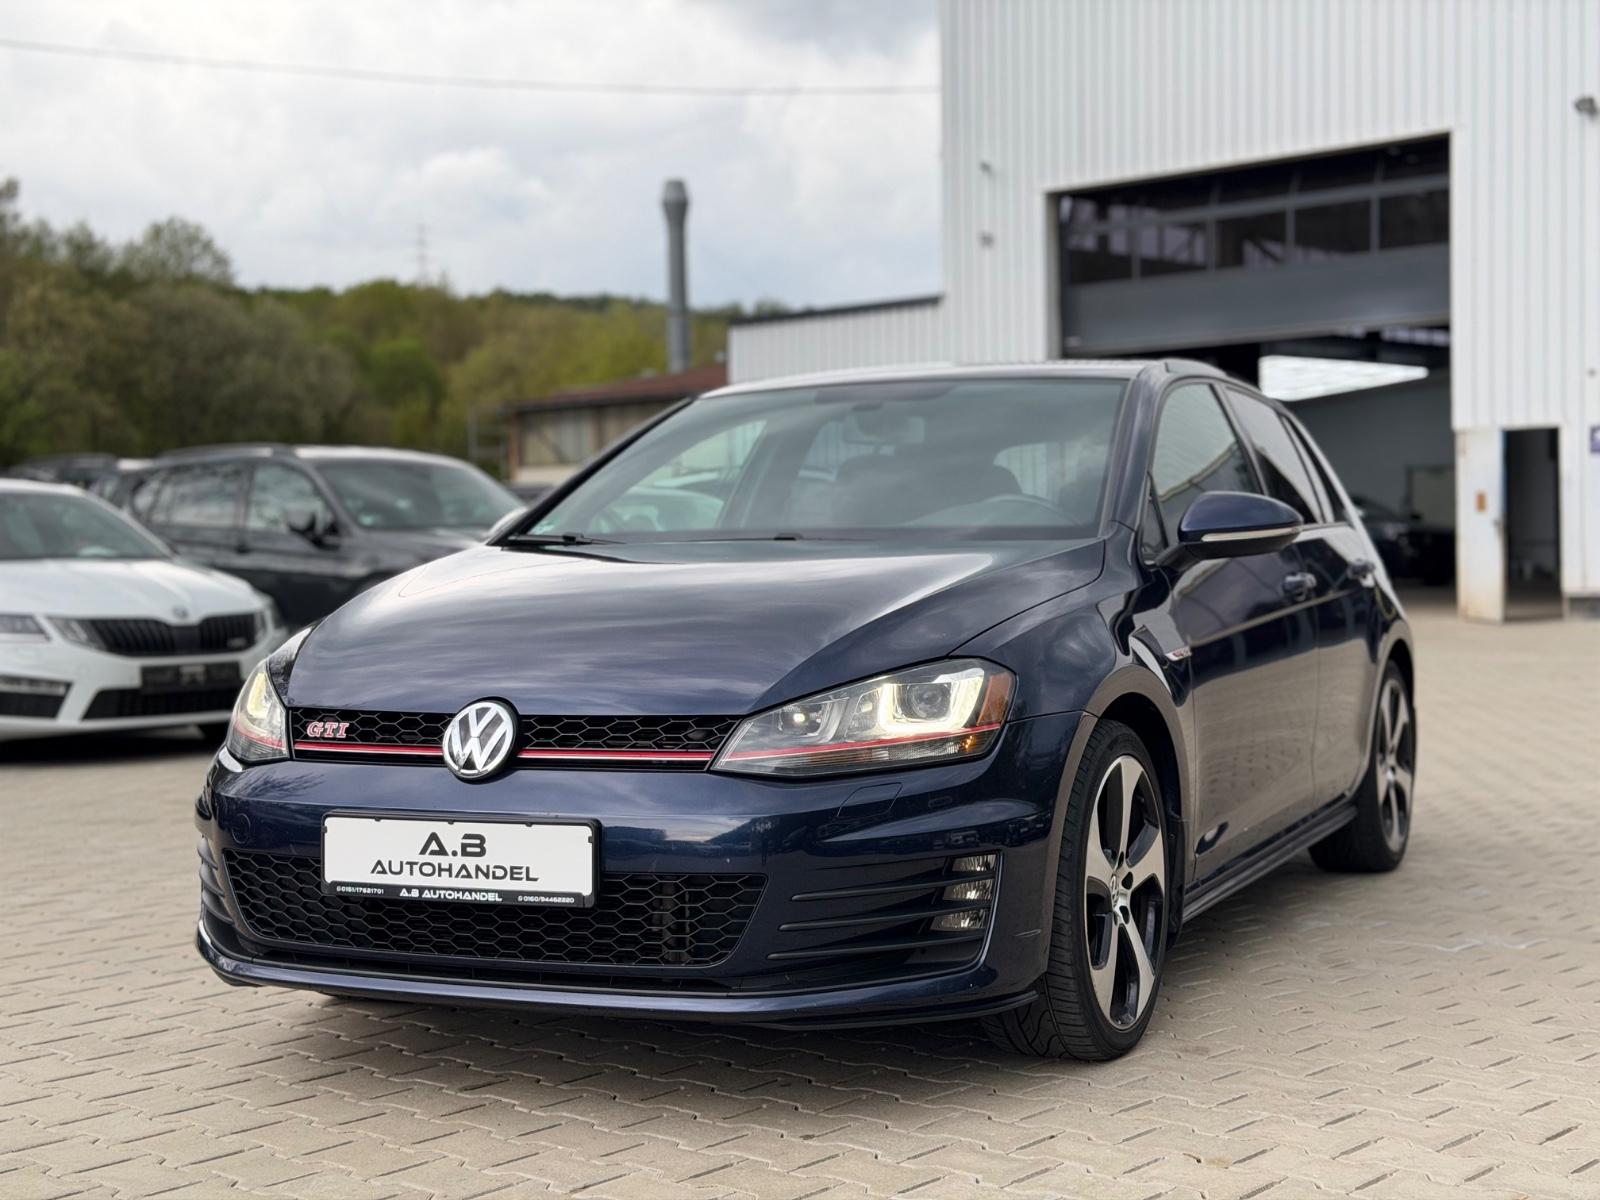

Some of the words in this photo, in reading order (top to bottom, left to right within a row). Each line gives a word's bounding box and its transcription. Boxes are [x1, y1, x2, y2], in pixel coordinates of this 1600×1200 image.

[306, 721, 350, 739] GTI
[418, 831, 487, 858] A.B
[370, 859, 540, 882] AUTOHANDEL
[399, 888, 420, 898] A.B
[422, 889, 503, 902] AUTOHANDEL
